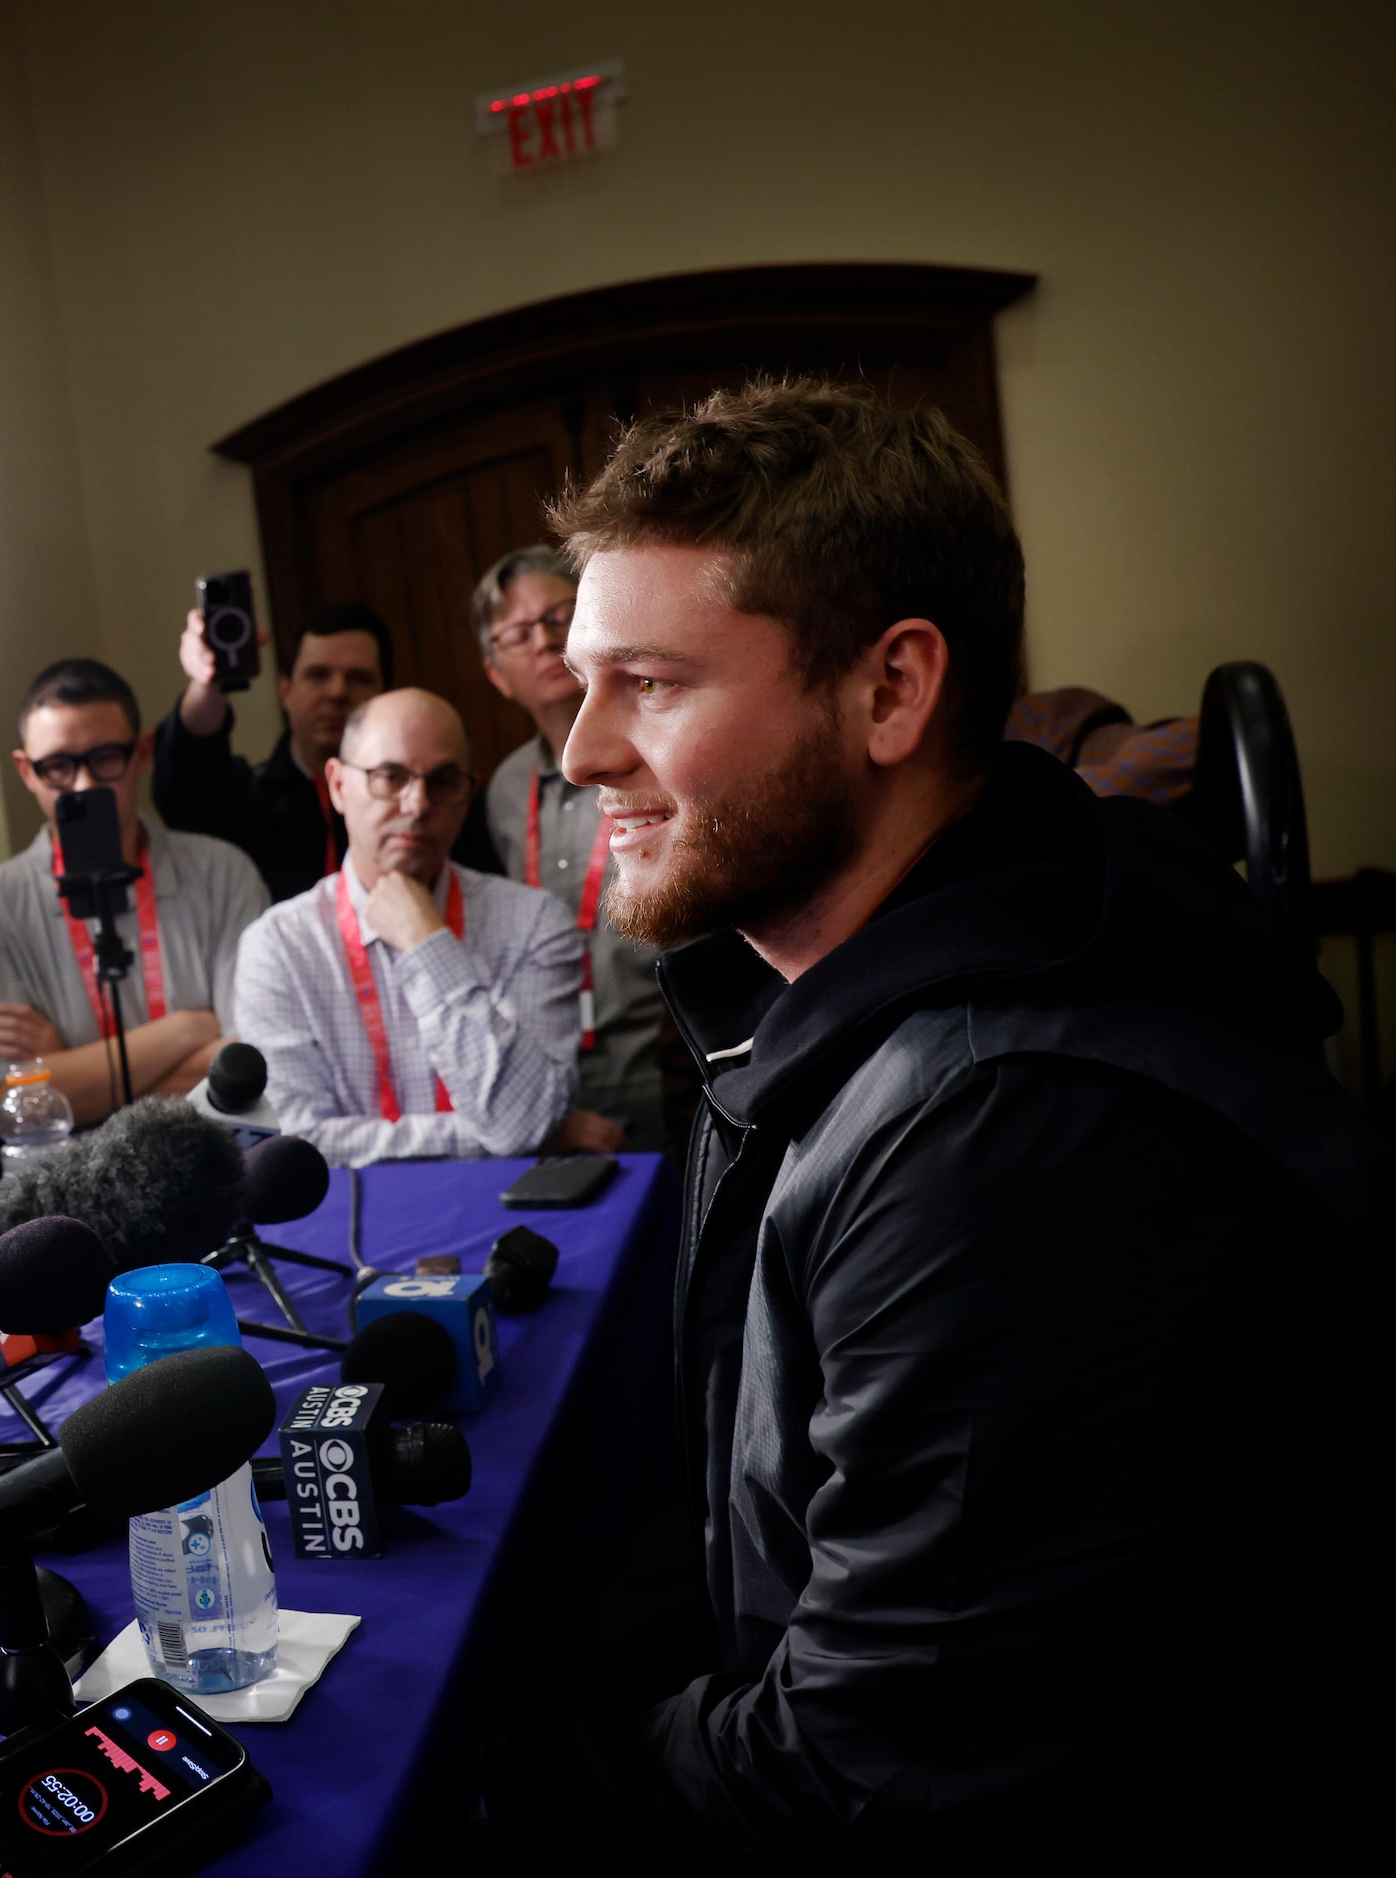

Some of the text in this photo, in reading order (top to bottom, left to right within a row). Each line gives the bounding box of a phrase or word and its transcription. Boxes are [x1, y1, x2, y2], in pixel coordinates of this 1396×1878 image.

[507, 87, 595, 169] EXIT
[290, 1386, 330, 1429] AUSTIN
[321, 1398, 361, 1428] CBS
[290, 1440, 326, 1552] AUSTIN
[325, 1473, 364, 1552] CBS
[40, 1774, 95, 1823] 00:02:55
